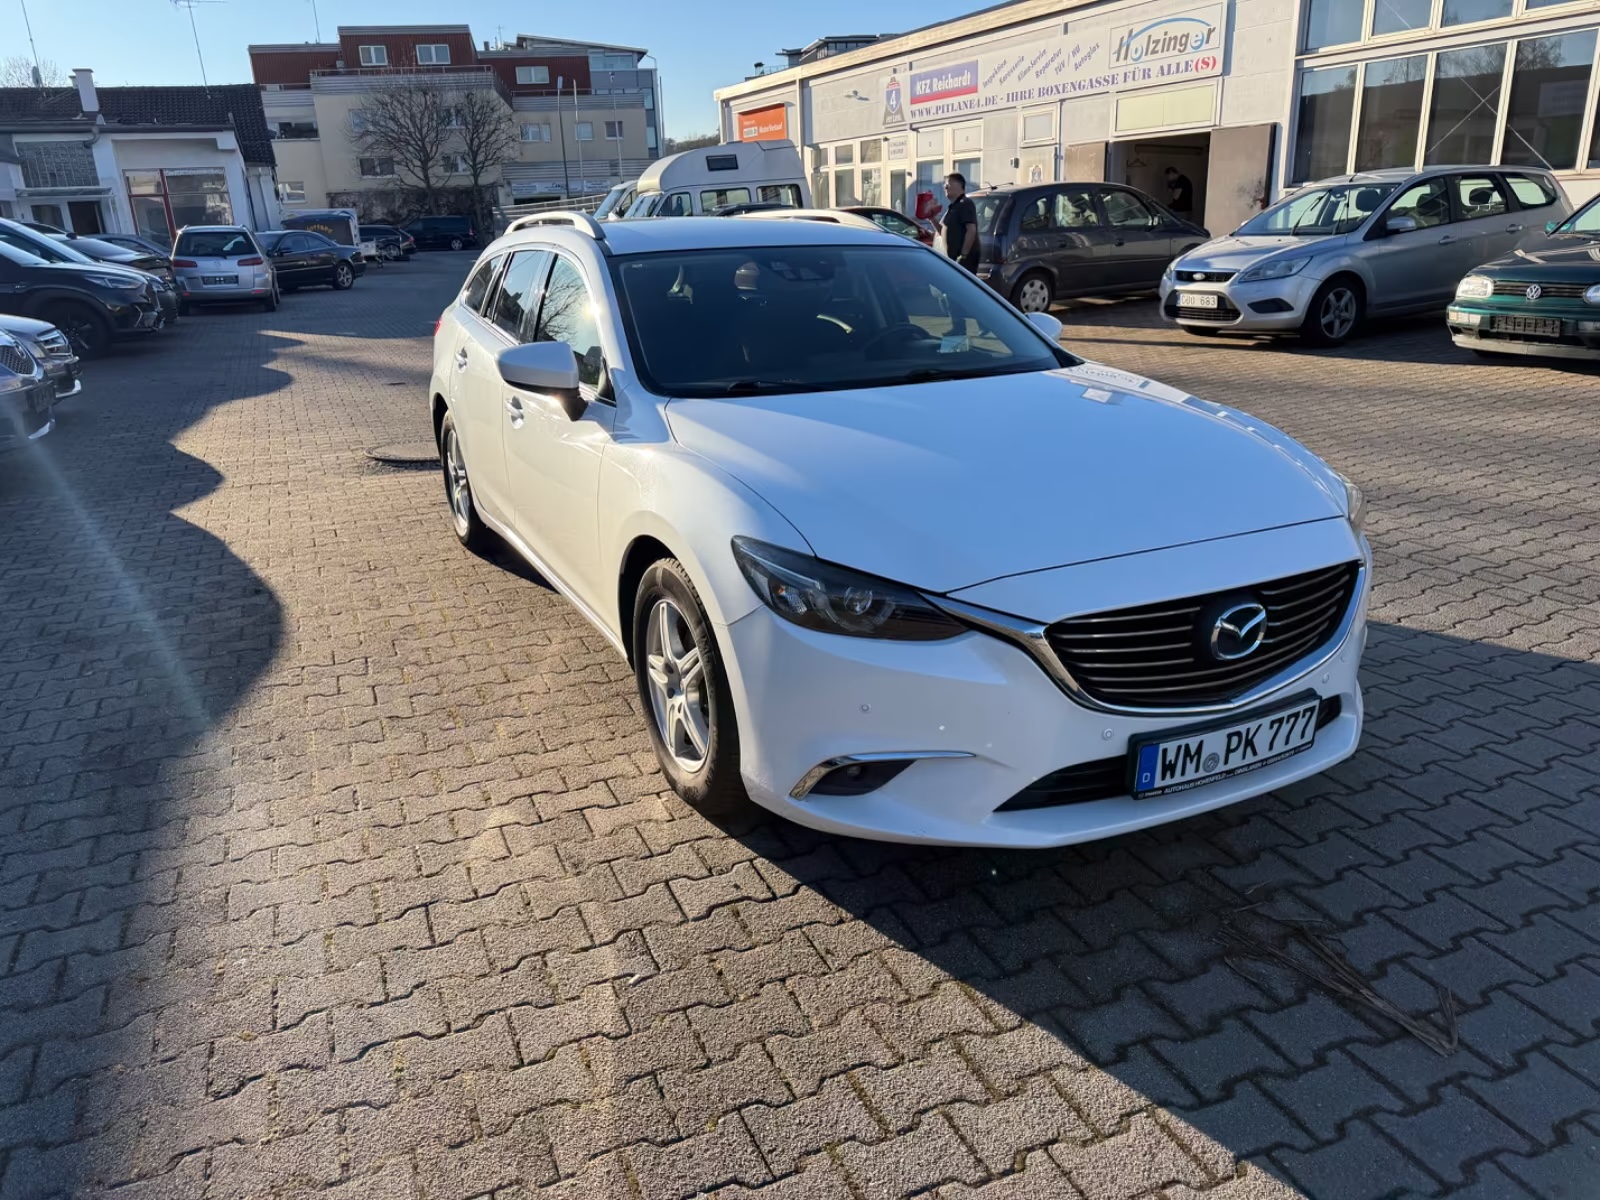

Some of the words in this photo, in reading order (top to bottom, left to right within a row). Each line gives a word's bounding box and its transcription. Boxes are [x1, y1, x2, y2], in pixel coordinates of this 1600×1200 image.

[1074, 42, 1100, 71] Autoglas
[1112, 27, 1216, 62] Holzinger
[910, 94, 998, 119] WWW.PITLANE4.DE
[1006, 87, 1035, 103] IHRE
[1038, 73, 1119, 98] BOXENGASSE
[1123, 66, 1152, 83] FÜR
[916, 79, 931, 95] KFZ
[932, 70, 971, 92] Reichardt
[890, 90, 896, 108] 4
[1142, 772, 1150, 783] D
[1161, 740, 1204, 781] WM
[1223, 723, 1263, 765] PK
[1268, 705, 1317, 751] 777
